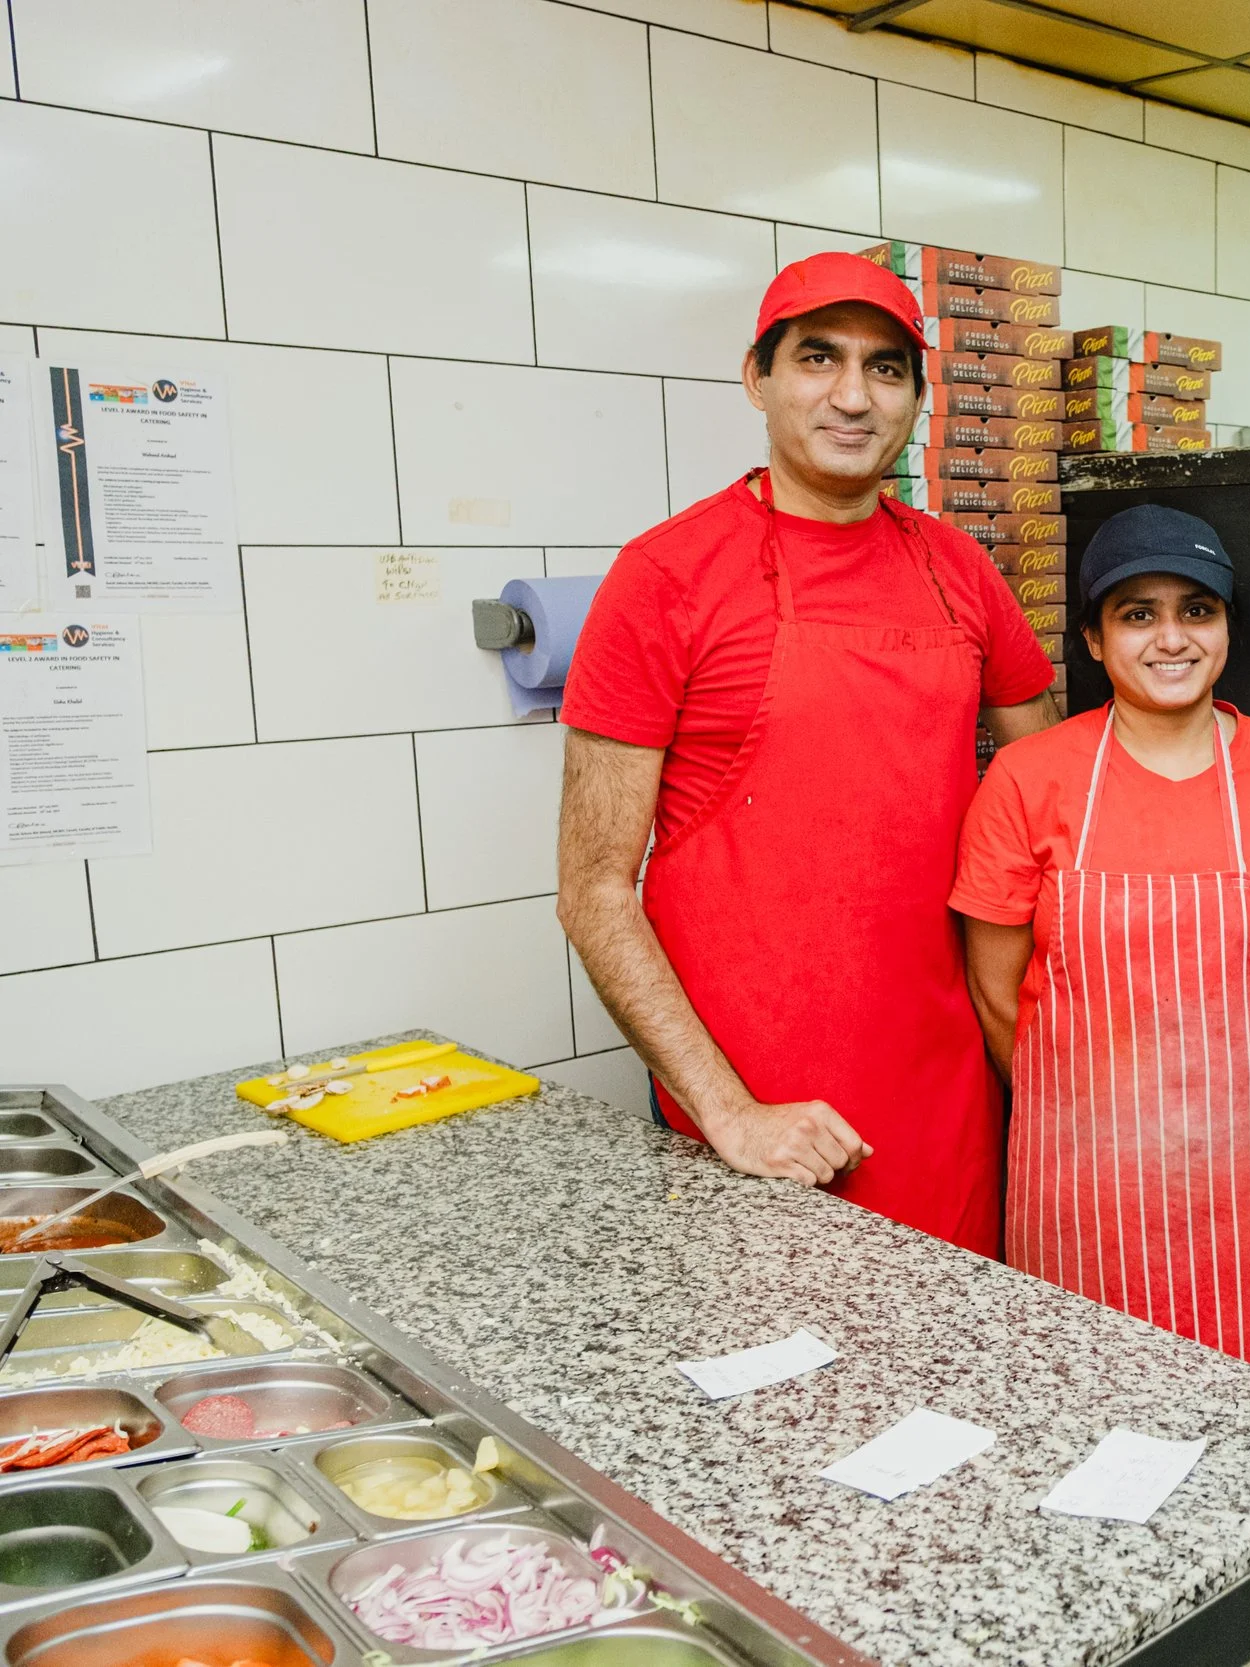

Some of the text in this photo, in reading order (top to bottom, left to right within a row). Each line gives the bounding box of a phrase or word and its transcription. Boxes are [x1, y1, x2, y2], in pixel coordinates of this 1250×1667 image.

[949, 262, 984, 273] FRESH &
[949, 271, 995, 283] DELICIOUS
[1010, 266, 1053, 290] Pizza
[949, 297, 975, 306] FRESH
[949, 305, 994, 315] DELICIOUS
[1009, 298, 1051, 322] Pizza
[965, 331, 991, 341] FRESH
[965, 339, 1009, 350] DELICIOUS
[1024, 332, 1065, 356] Pizza
[1082, 335, 1108, 356] Pizza
[1188, 347, 1216, 363] Pizza
[953, 363, 987, 371] FRESH &
[1012, 362, 1053, 386] Pizza
[953, 370, 997, 380] DELICIOUS
[1068, 366, 1093, 386] Pizza
[1175, 375, 1204, 392] Pizza
[958, 394, 984, 403] FRESH
[1017, 393, 1058, 417] Pizza
[958, 402, 1002, 411] DELICIOUS
[1066, 398, 1092, 417] Pizza
[1173, 406, 1200, 424] Pizza
[983, 427, 989, 435] &
[1014, 425, 1055, 448] Pizza
[955, 434, 999, 443] DELICIOUS
[1070, 429, 1096, 449] Pizza
[950, 458, 976, 467] FRESH
[1008, 456, 1049, 480] Pizza
[950, 466, 993, 474] DELICIOUS
[953, 491, 979, 499] FRESH
[1012, 487, 1052, 512] Pizza
[953, 498, 997, 507] DELICIOUS
[963, 524, 988, 532] FRESH
[969, 531, 1006, 539] ELICIOUS
[1020, 519, 1058, 543] Pizza
[1019, 550, 1058, 573] Pizza
[1018, 579, 1058, 604] Pizza
